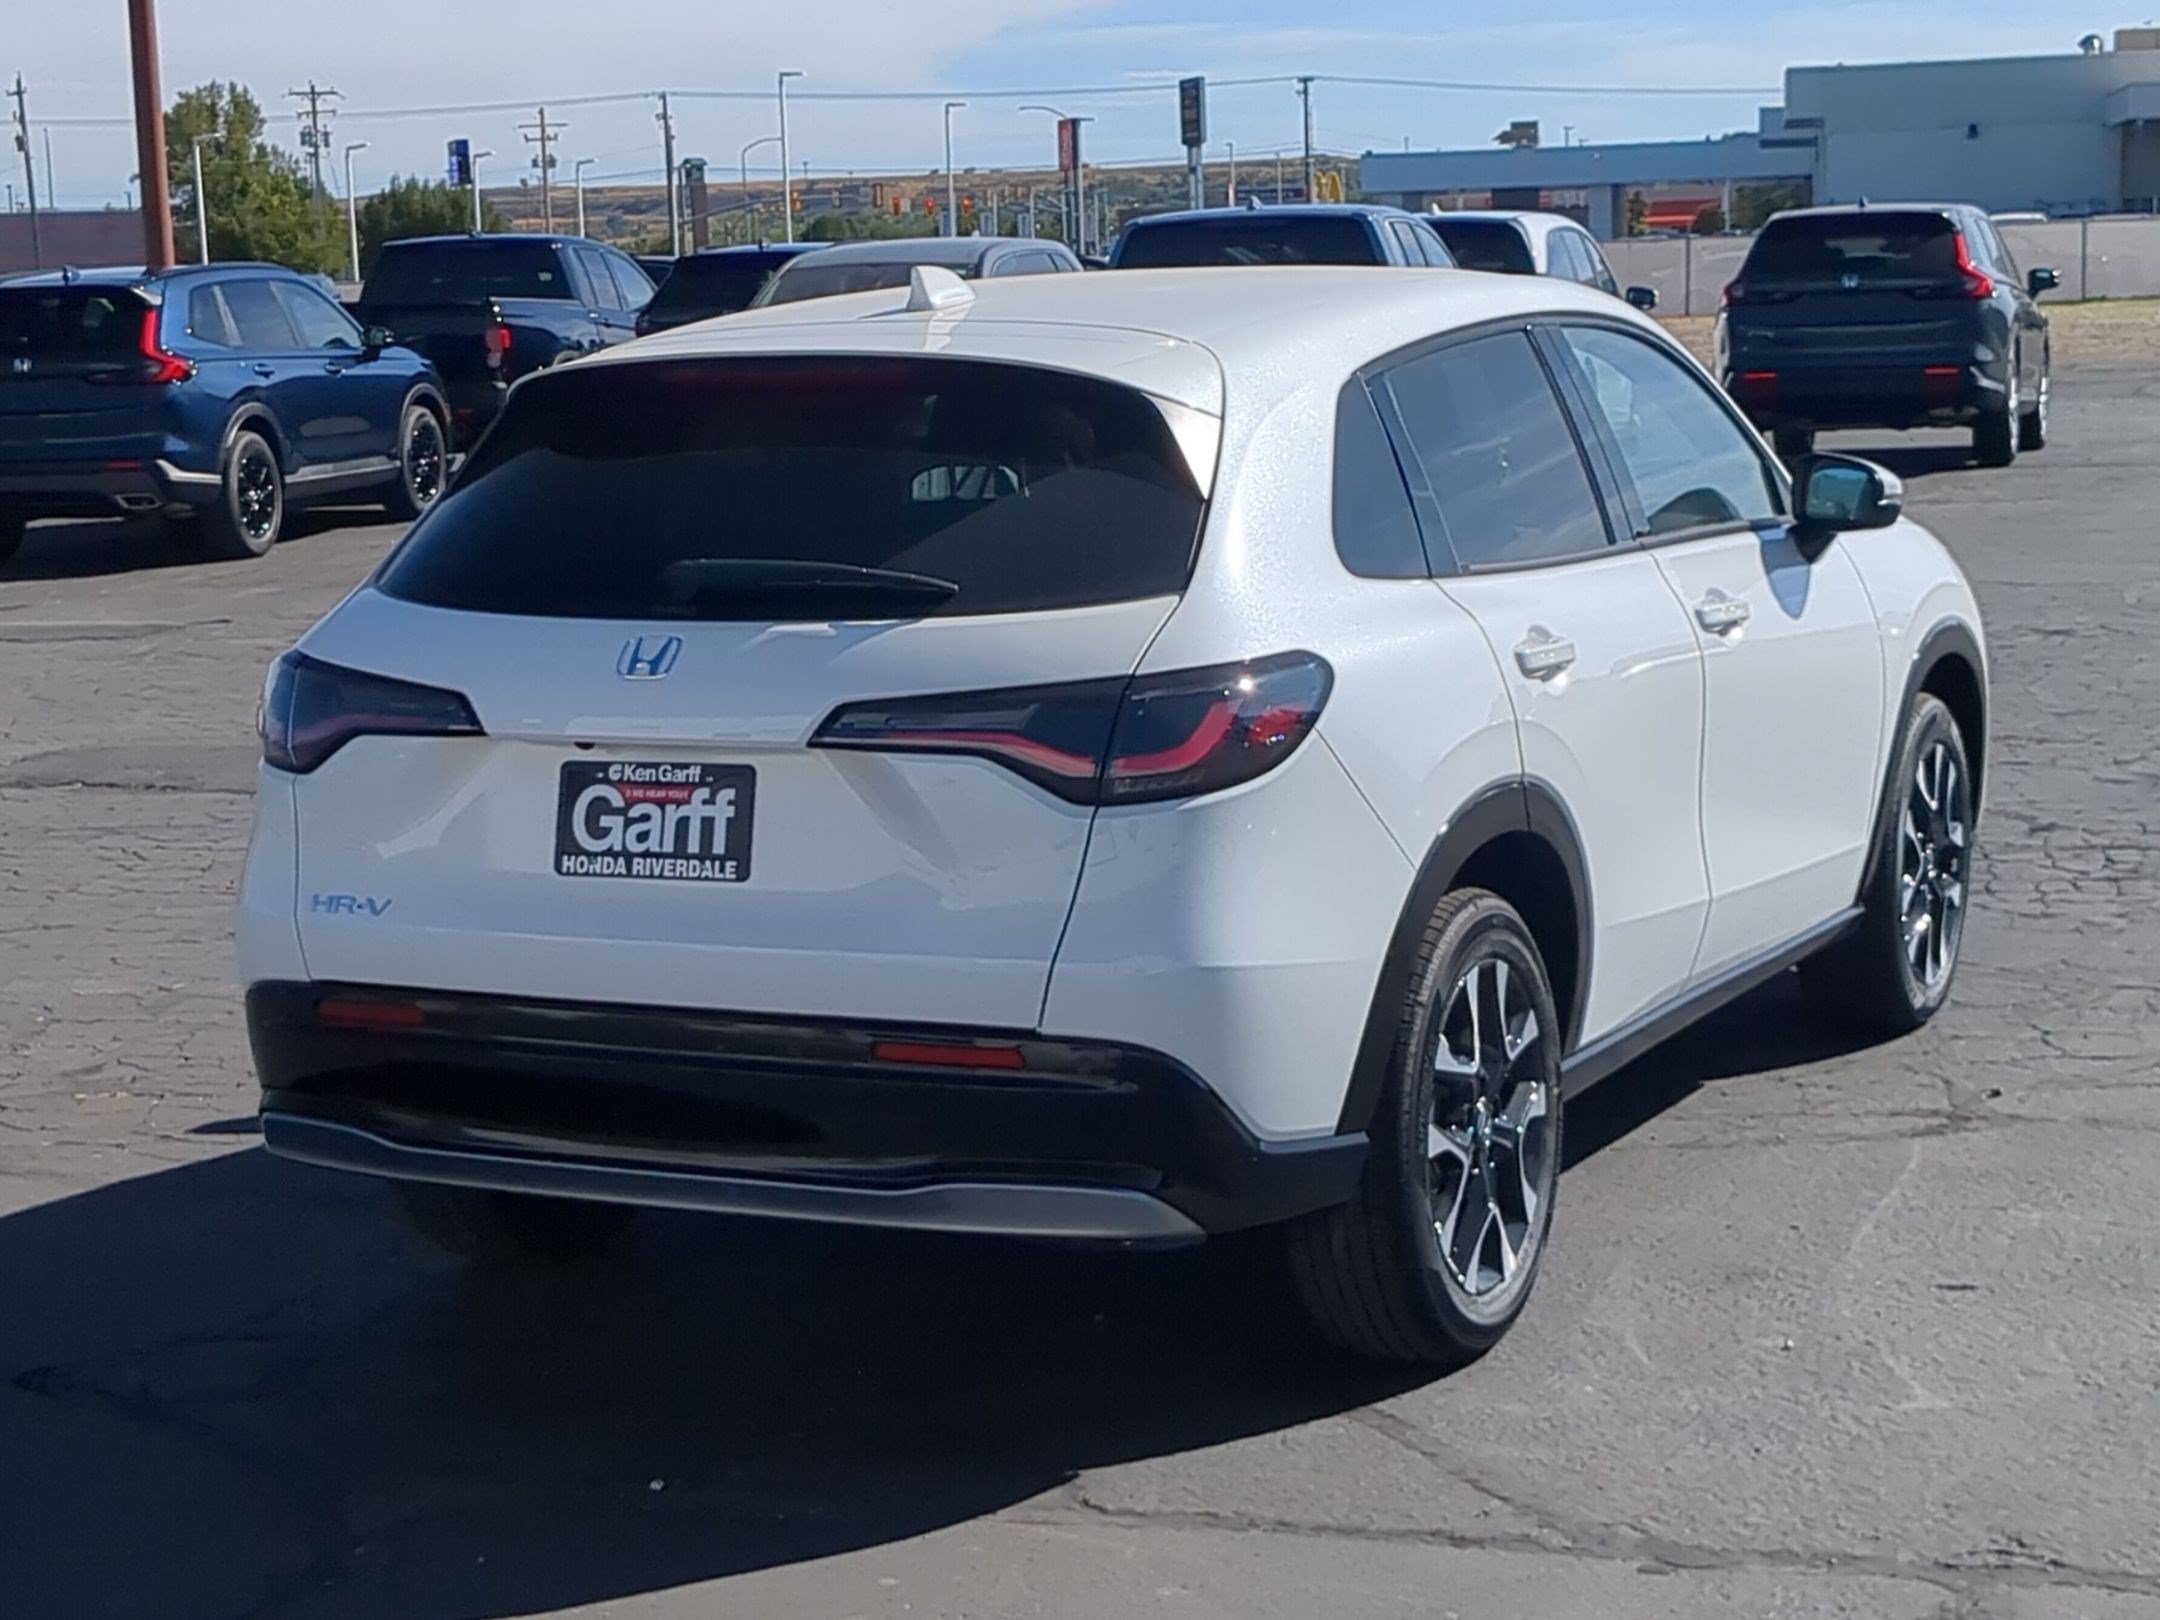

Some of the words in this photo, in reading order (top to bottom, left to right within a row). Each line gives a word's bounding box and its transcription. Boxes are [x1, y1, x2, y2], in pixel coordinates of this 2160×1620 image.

[623, 764, 656, 782] Ken
[658, 764, 702, 783] Garff
[572, 784, 736, 855] Garff
[561, 854, 627, 876] HONDA
[632, 857, 737, 880] RIVERDALE
[311, 894, 392, 916] HR-V
